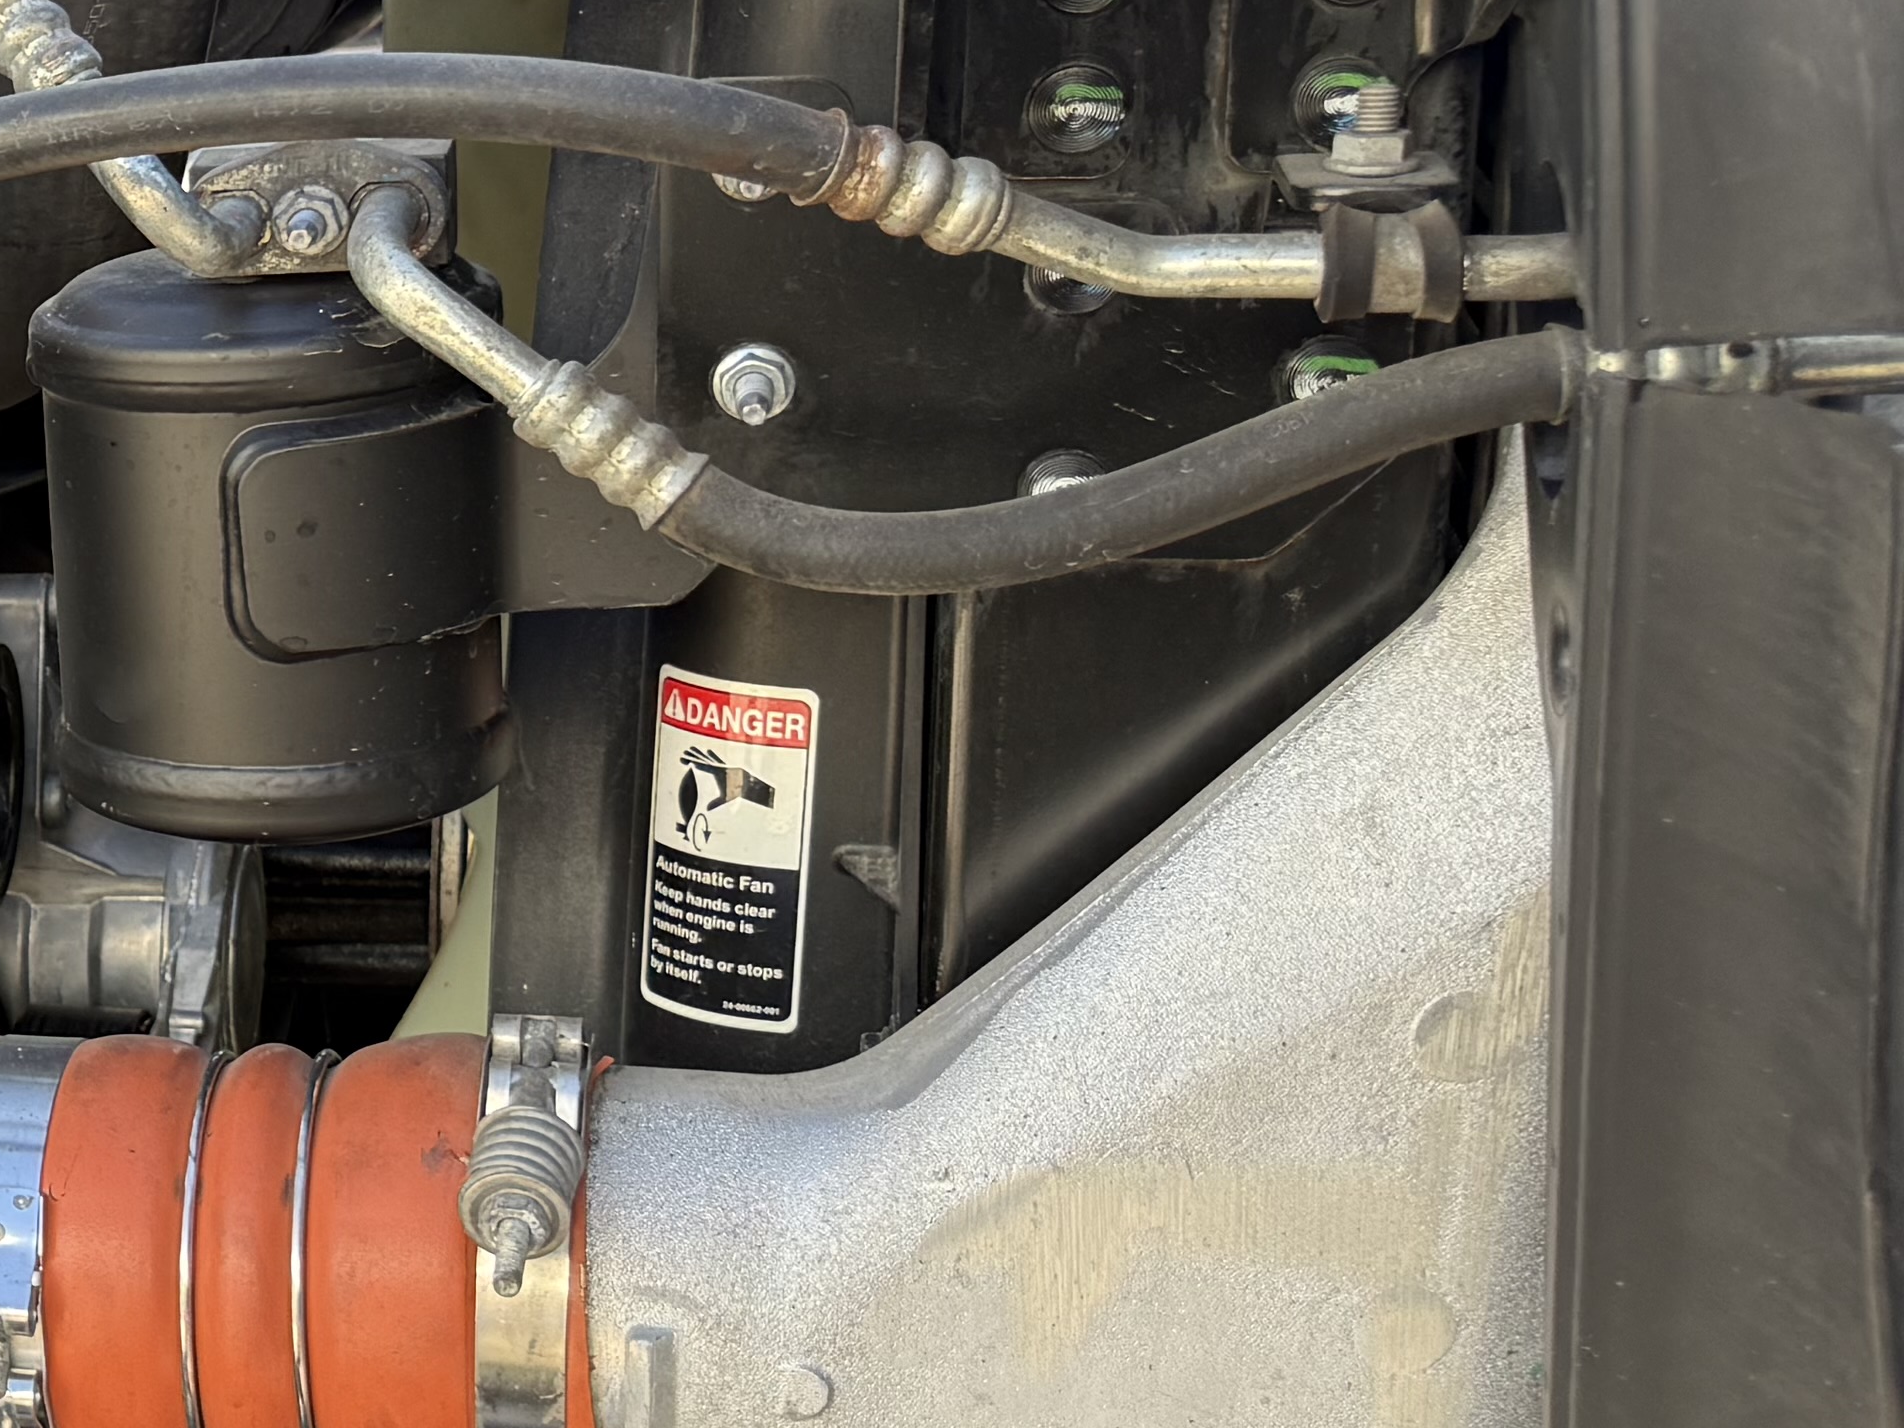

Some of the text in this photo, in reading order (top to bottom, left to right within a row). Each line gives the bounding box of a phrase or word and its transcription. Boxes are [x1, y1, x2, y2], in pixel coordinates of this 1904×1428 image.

[686, 697, 805, 741] DANGER
[656, 855, 775, 894] Automatic Fan
[654, 899, 754, 934] when engine is
[655, 879, 776, 919] Keep hands clear
[653, 917, 702, 944] running.
[651, 956, 702, 984] by itself.
[652, 938, 783, 980] Fan starts or stops
